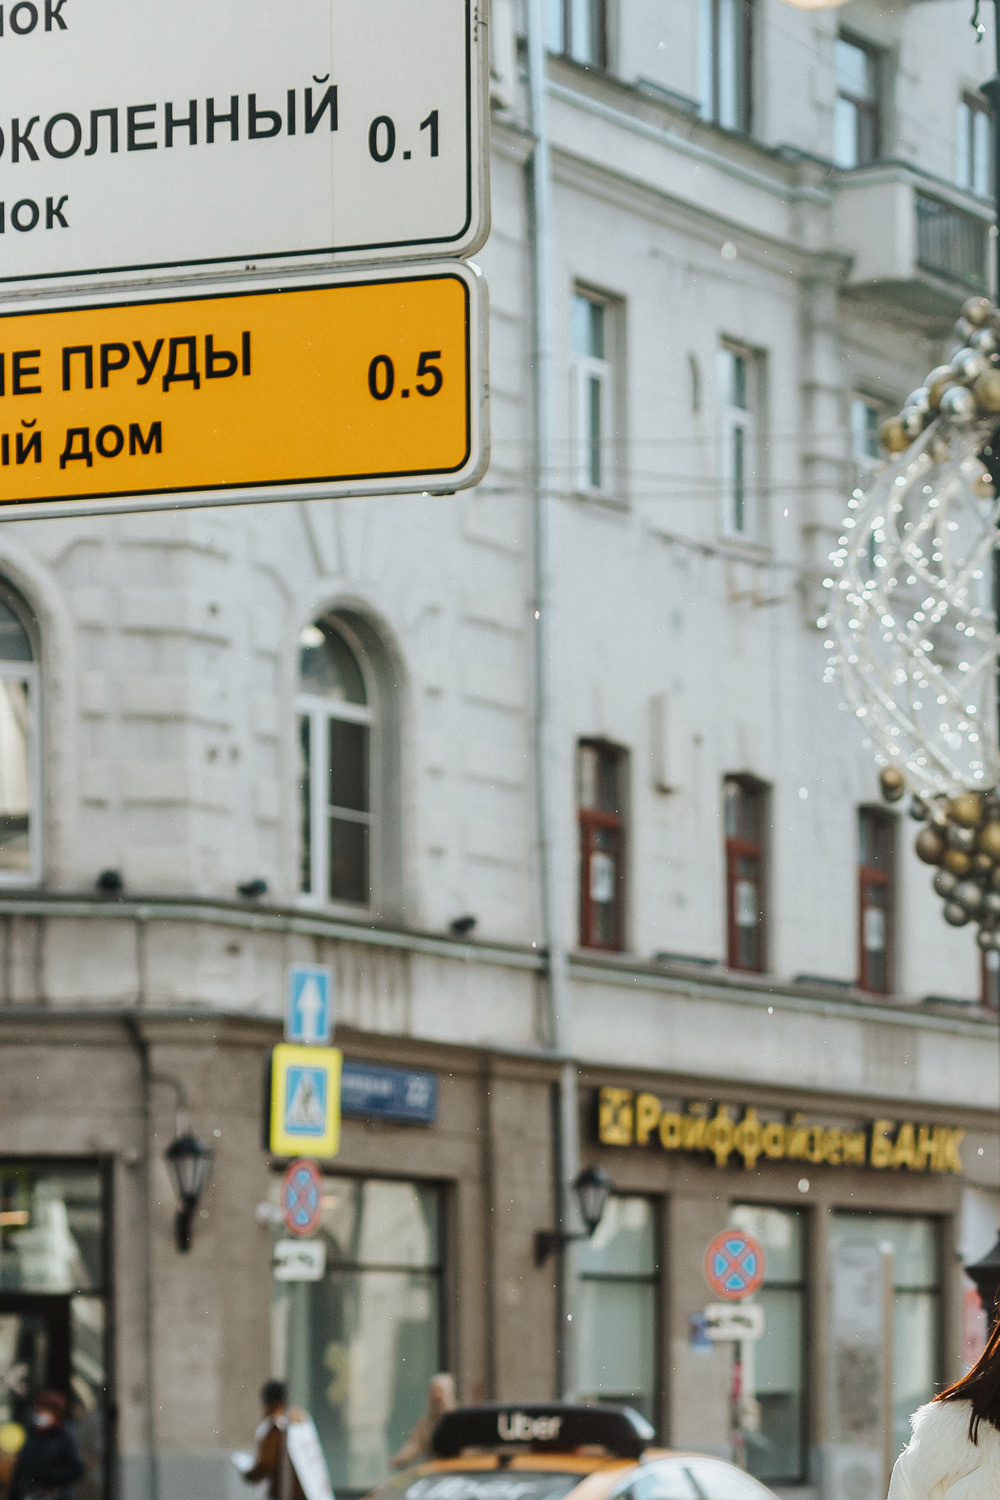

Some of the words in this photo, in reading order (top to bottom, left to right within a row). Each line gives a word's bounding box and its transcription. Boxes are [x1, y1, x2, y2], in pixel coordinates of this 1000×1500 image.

[0, 0, 68, 37] ок
[0, 73, 340, 164] КОЛЕННЫЙ
[368, 109, 440, 163] 0.1
[0, 194, 70, 234] ок
[0, 349, 42, 397] Е
[61, 331, 252, 393] ПРУДЫ
[367, 350, 443, 401] 0.5
[59, 420, 163, 470] дом
[870, 1119, 965, 1174] БАНК
[497, 1411, 562, 1441] Uber
